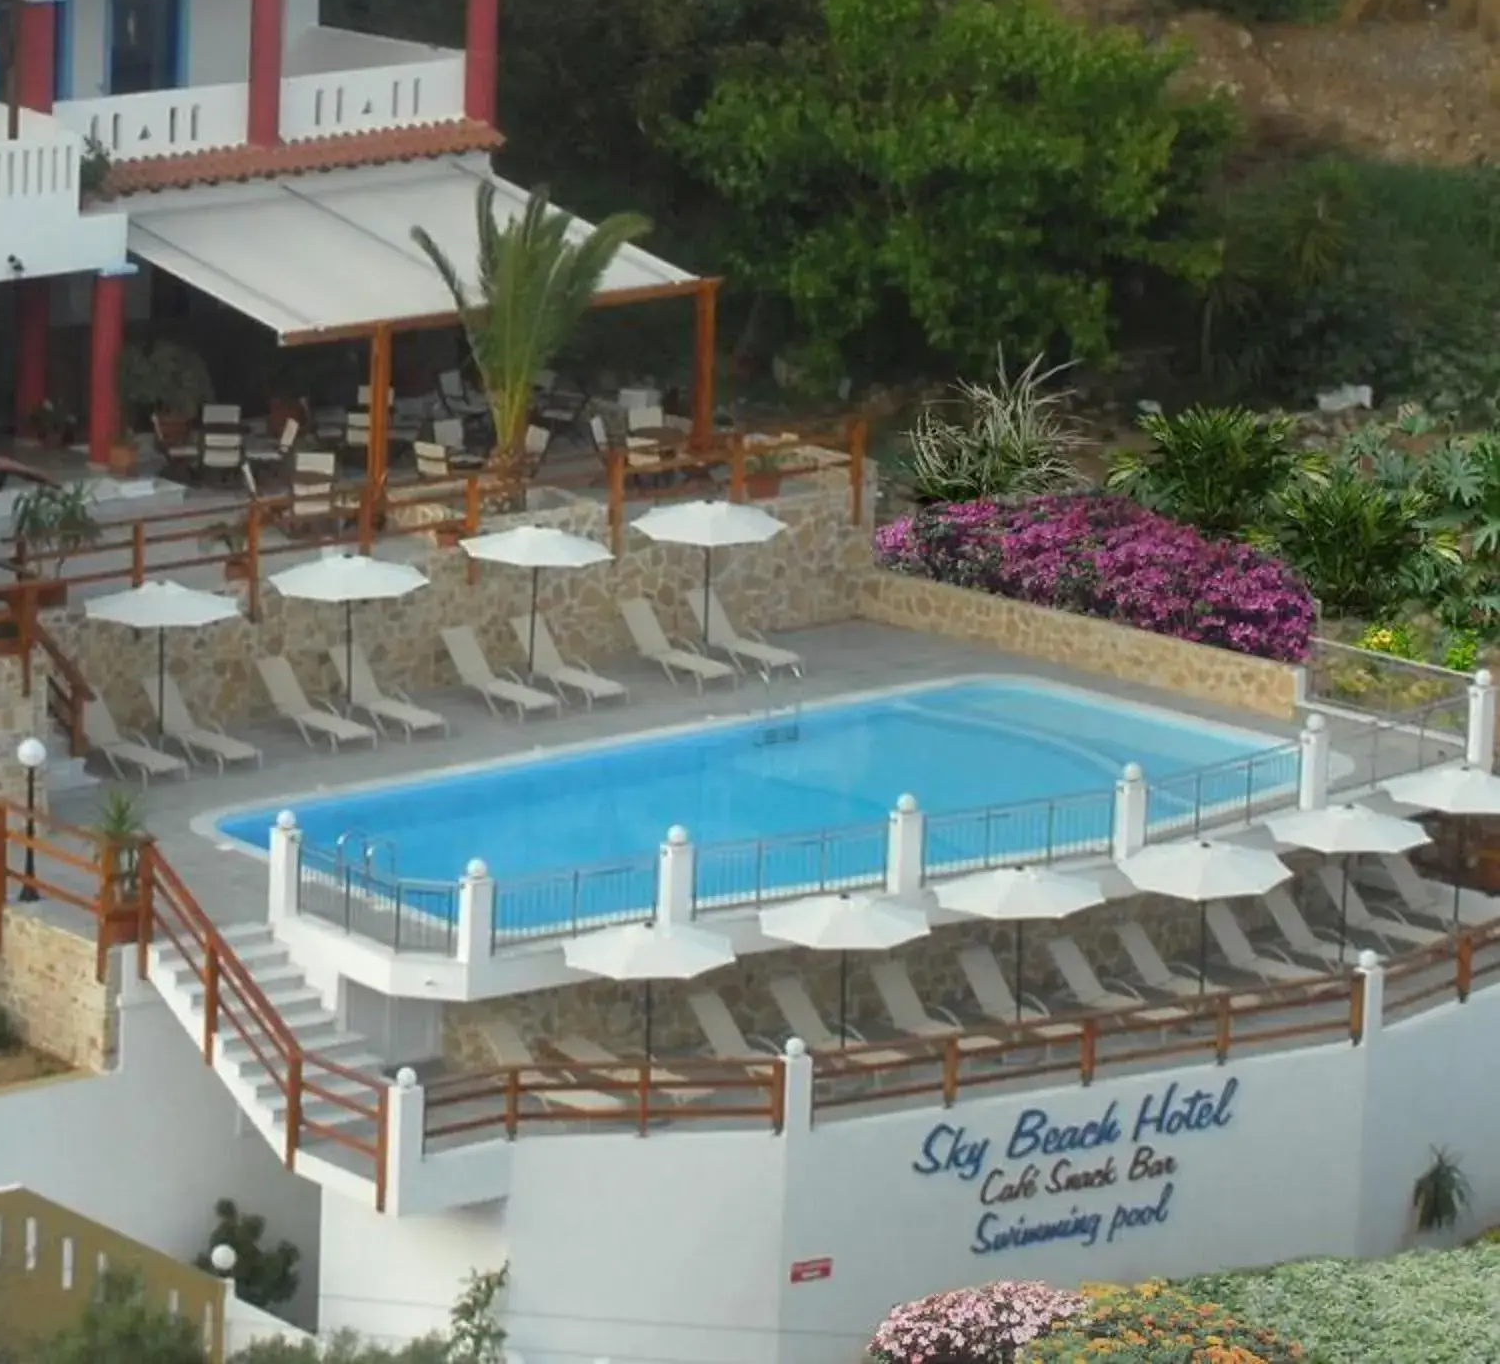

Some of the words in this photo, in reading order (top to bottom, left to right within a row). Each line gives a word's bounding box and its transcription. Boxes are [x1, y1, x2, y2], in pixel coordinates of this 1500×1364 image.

[913, 1123, 990, 1180] Sky
[1006, 1100, 1122, 1159] Beach
[1131, 1077, 1239, 1141] Hotel
[980, 1163, 1041, 1205] Café
[1045, 1156, 1118, 1194] Snack
[1127, 1145, 1179, 1181] Bar
[970, 1205, 1102, 1255] Swimming
[1106, 1182, 1175, 1243] pool
